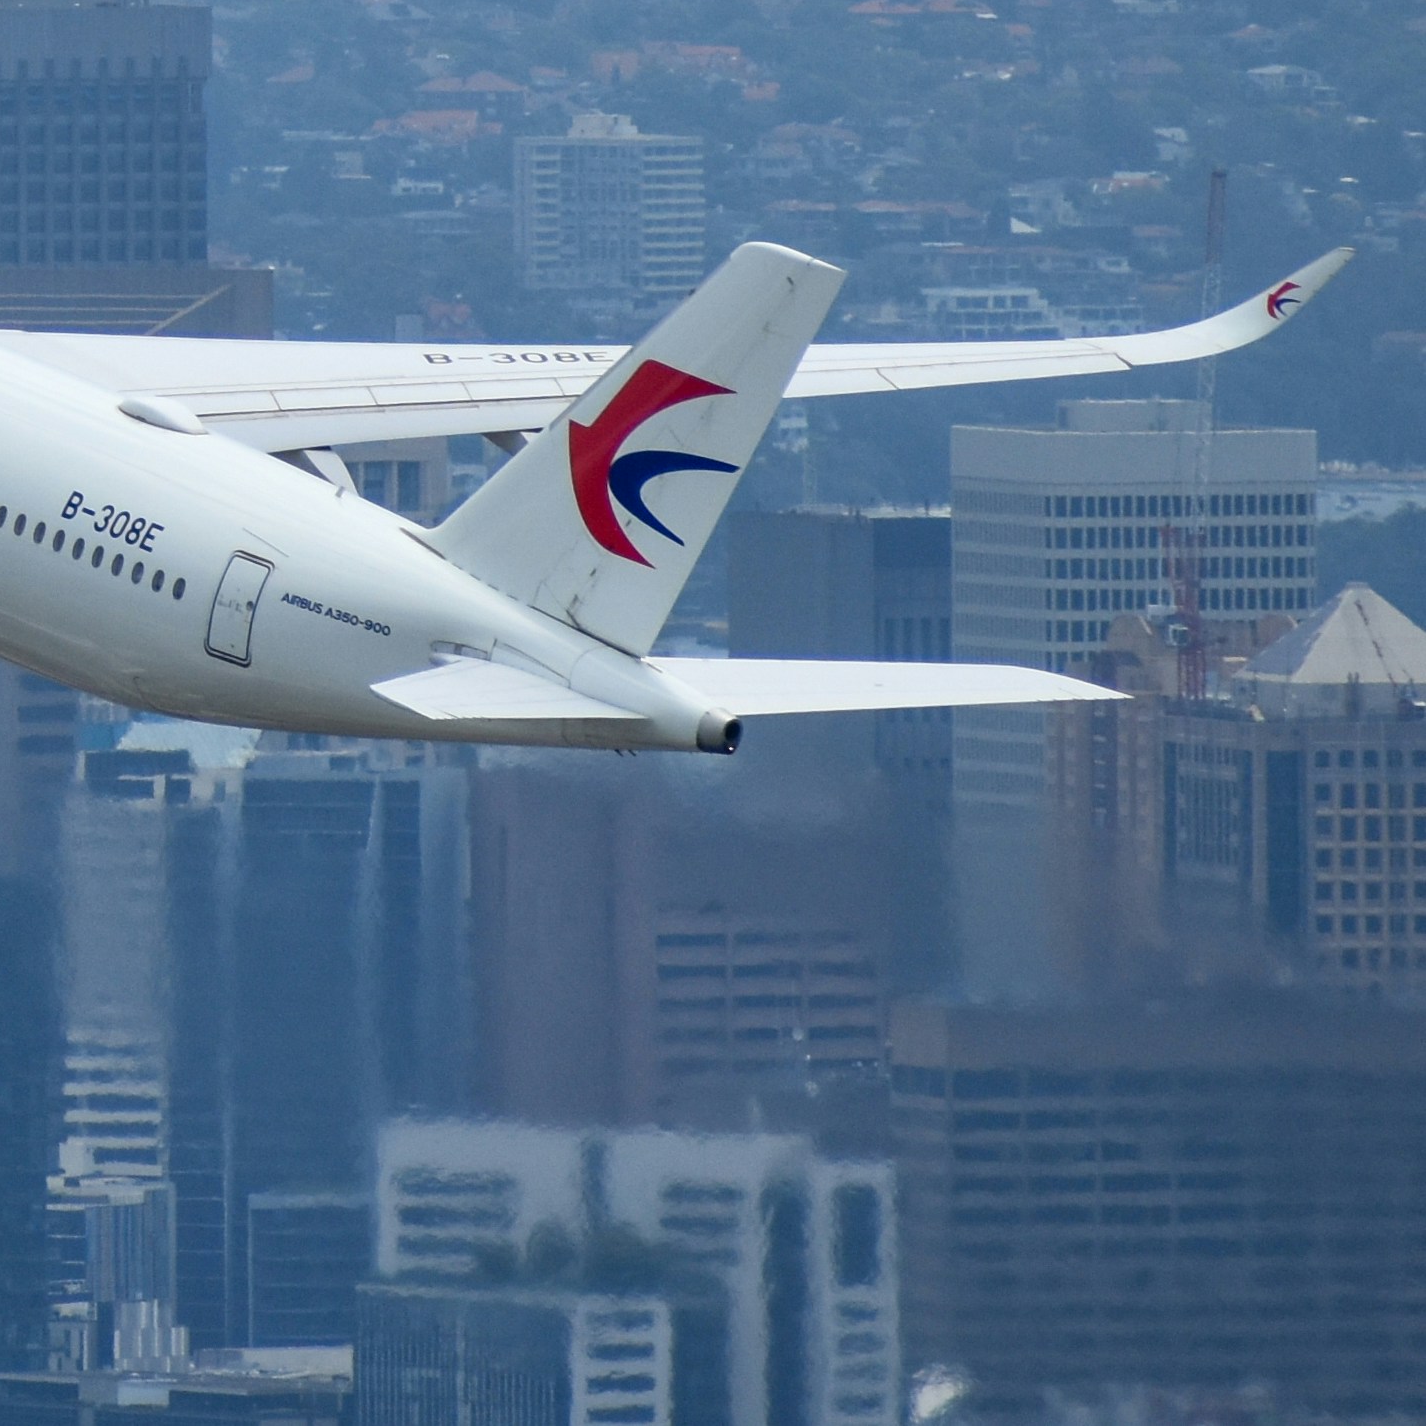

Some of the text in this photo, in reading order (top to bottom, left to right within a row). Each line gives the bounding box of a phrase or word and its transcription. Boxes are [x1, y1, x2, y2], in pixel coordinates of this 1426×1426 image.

[423, 351, 614, 365] B-308E
[60, 490, 166, 553] B-308E
[280, 592, 392, 637] AIRBUS A350-900
